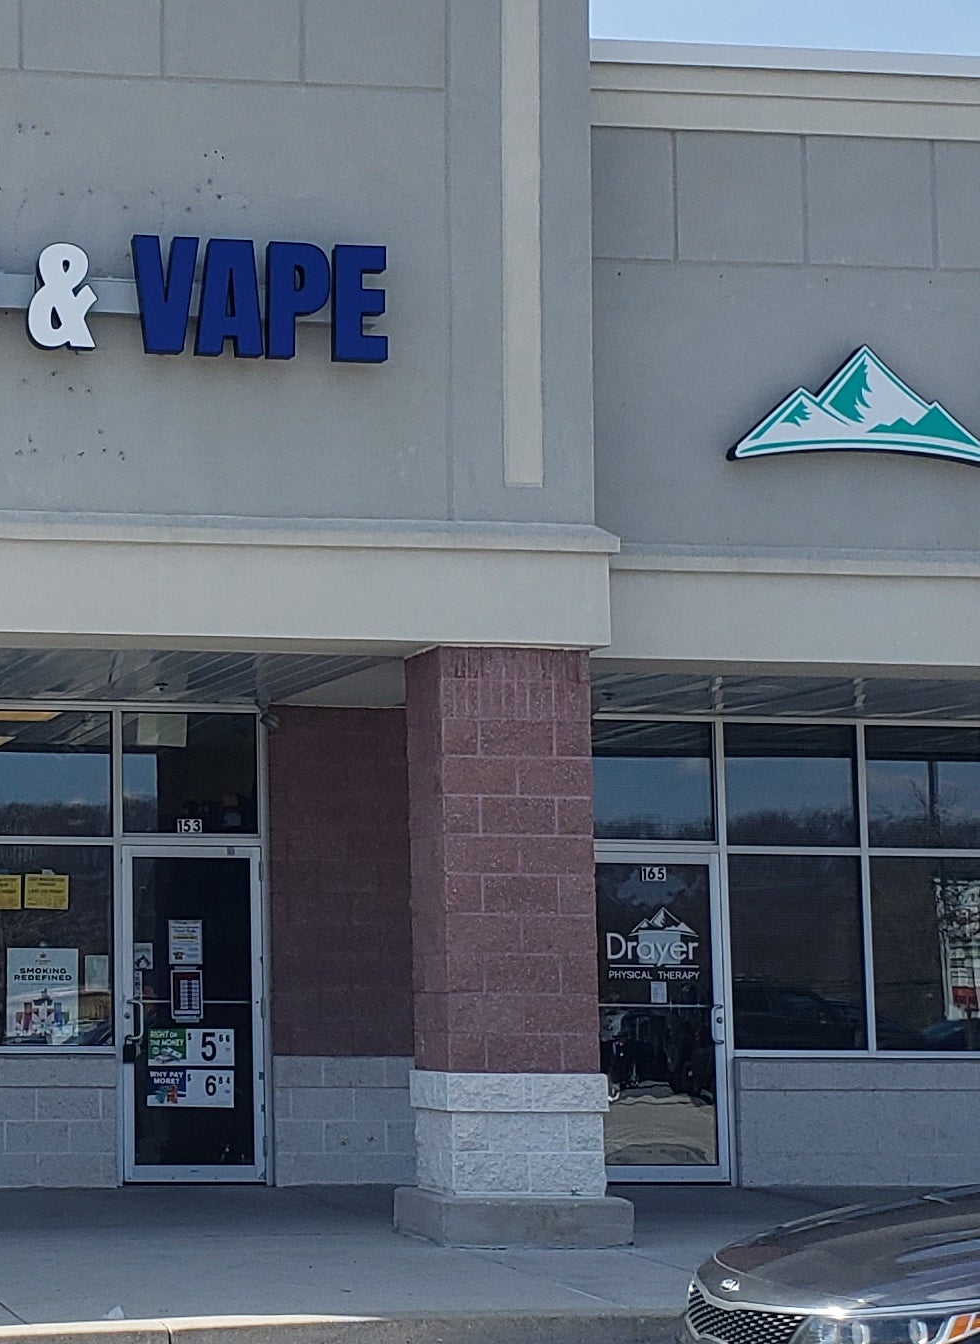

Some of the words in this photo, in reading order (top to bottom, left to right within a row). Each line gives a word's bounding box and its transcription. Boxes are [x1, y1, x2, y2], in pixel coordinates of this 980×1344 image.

[26, 241, 98, 352] &
[131, 234, 390, 364] VAPE
[179, 819, 201, 832] 153
[641, 867, 666, 881] 165
[606, 932, 699, 967] Drayer
[19, 967, 67, 975] SMOKING
[608, 970, 653, 980] PHYSICAL
[657, 970, 701, 980] THERAPY
[13, 974, 73, 982] REDEFINED
